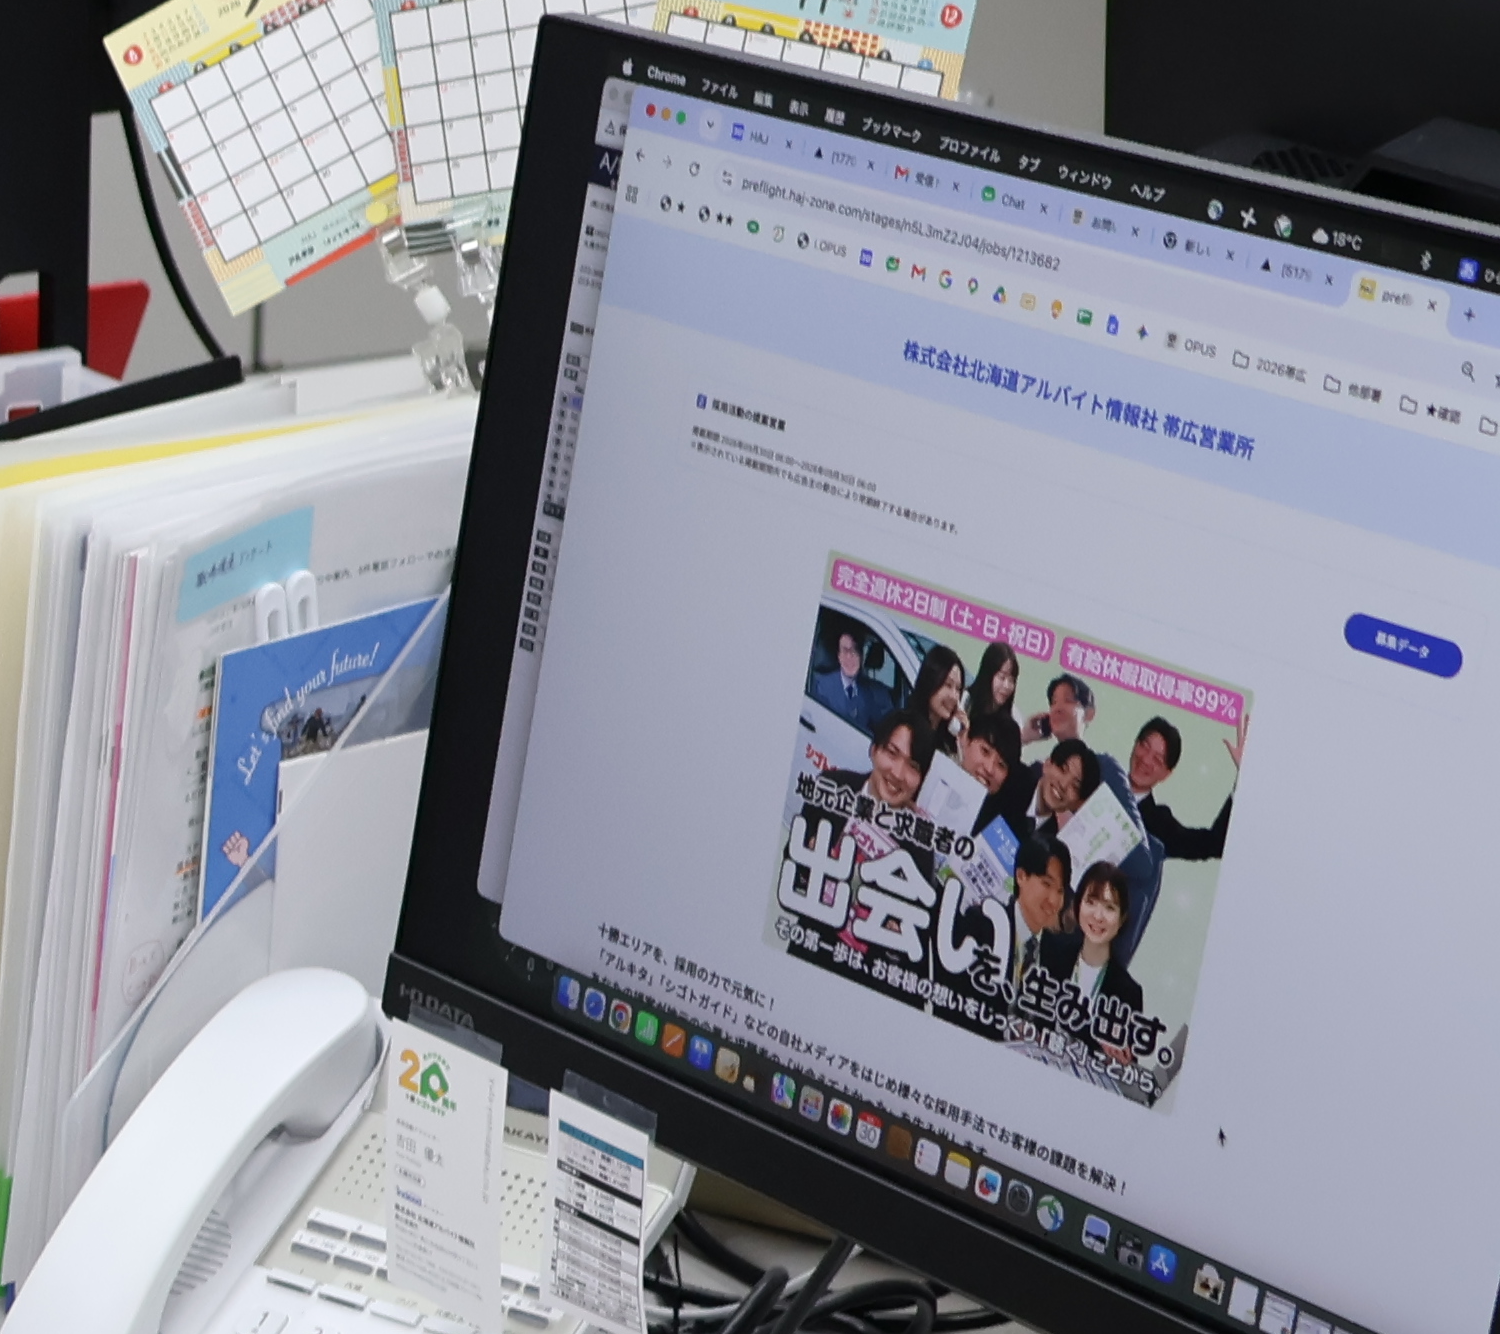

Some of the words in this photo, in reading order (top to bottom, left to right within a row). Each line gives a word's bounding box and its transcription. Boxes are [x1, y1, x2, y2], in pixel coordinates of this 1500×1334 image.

[943, 8, 959, 23] 12
[647, 66, 686, 87] Chrome
[702, 78, 739, 99] ファイル
[753, 89, 774, 109] 編集
[789, 99, 809, 118] 表示
[825, 107, 846, 127] 履歴
[862, 117, 921, 144] ブックマーク
[939, 136, 1001, 164] プロファイル
[1019, 154, 1041, 172] タブ
[1058, 165, 1112, 190] ウィンドウ
[1130, 184, 1166, 202] ヘルプ
[1001, 193, 1025, 211] Chat
[1184, 338, 1217, 359] OPUS
[903, 339, 1158, 434] 株式会社北海道アルバイト情報社
[1163, 413, 1255, 461] 帯広営業所
[1067, 637, 1238, 720] 有給休暇取得率99%
[263, 687, 293, 740] find
[296, 669, 327, 708] your
[328, 641, 381, 687] future!
[795, 772, 977, 861] 地元企業と求職者の
[504, 1126, 549, 1146] AKAY
[858, 1125, 877, 1145] 30
[258, 1310, 269, 1327] 1
